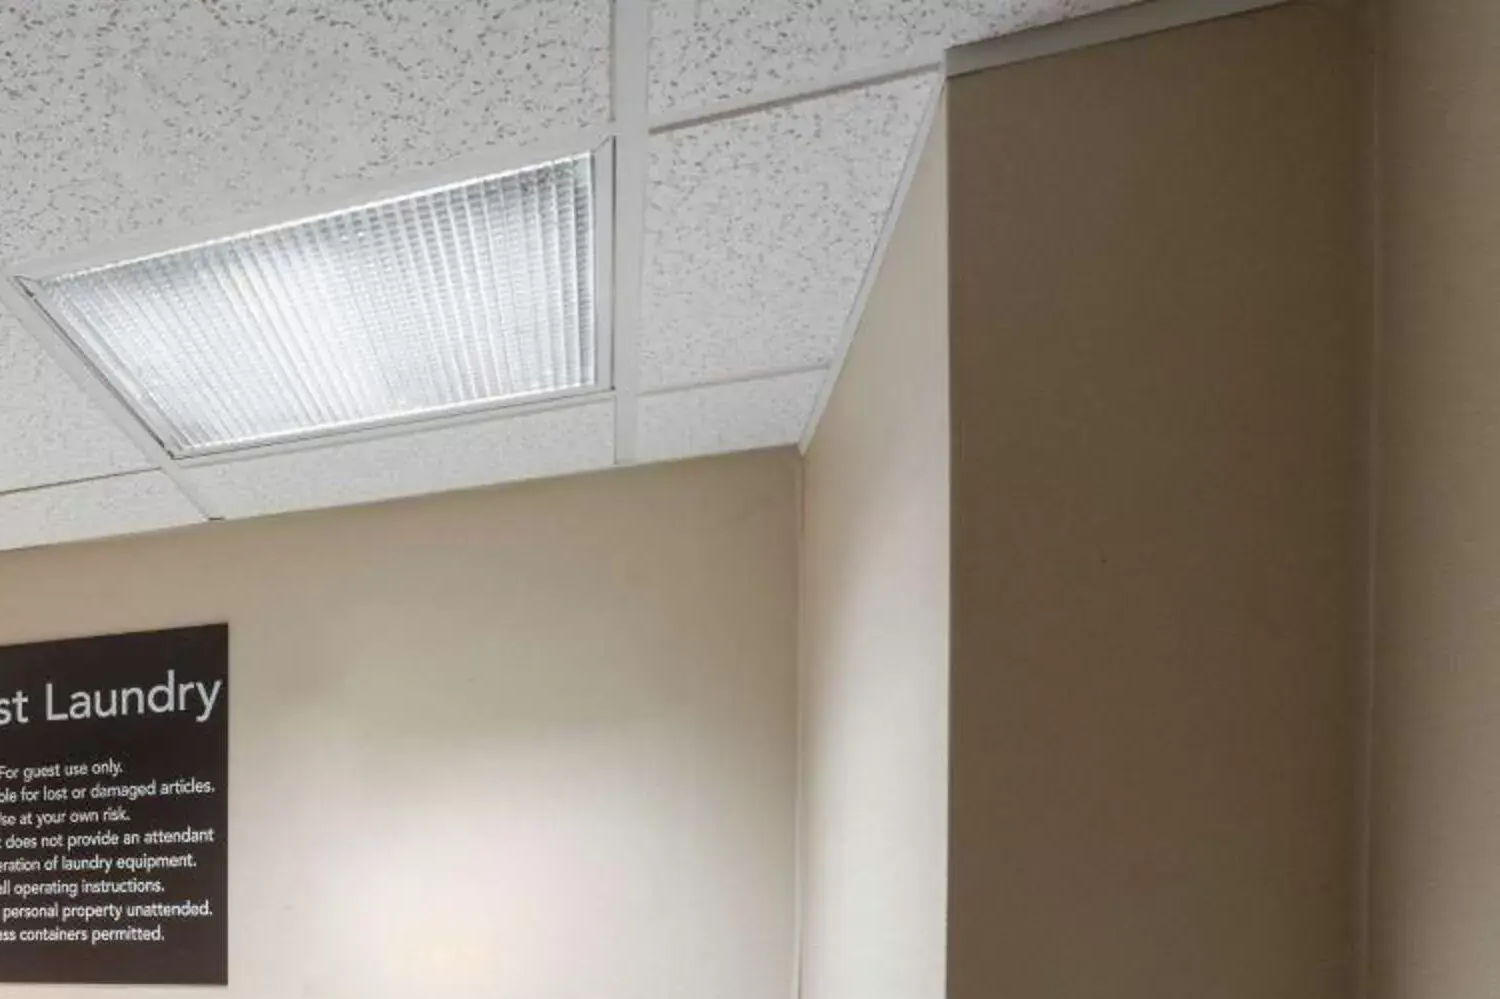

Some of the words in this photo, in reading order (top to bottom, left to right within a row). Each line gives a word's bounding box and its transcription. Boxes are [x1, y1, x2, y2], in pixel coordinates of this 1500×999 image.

[45, 669, 222, 723] Laundry
[23, 763, 61, 783] guest
[64, 763, 88, 777] use
[91, 757, 123, 778] only.
[21, 786, 39, 801] for
[43, 784, 68, 801] lost
[71, 787, 86, 800] or
[90, 778, 157, 800] damaged
[160, 776, 215, 796] articles.
[19, 812, 33, 826] at
[36, 810, 66, 829] your
[69, 810, 99, 823] own
[103, 805, 131, 822] risk.
[5, 834, 38, 849] does
[41, 834, 64, 848] not
[66, 829, 119, 851] provide
[123, 832, 140, 845] an
[143, 825, 214, 844] attendant
[43, 854, 59, 871] of
[61, 853, 112, 874] laundry
[115, 851, 197, 874] equipment.
[13, 879, 78, 899] operating
[81, 878, 165, 894] instructions.
[2, 901, 59, 923] personal
[61, 903, 123, 923] property
[126, 899, 213, 917] unattended.
[19, 926, 88, 942] containers
[91, 923, 165, 945] permitted.
